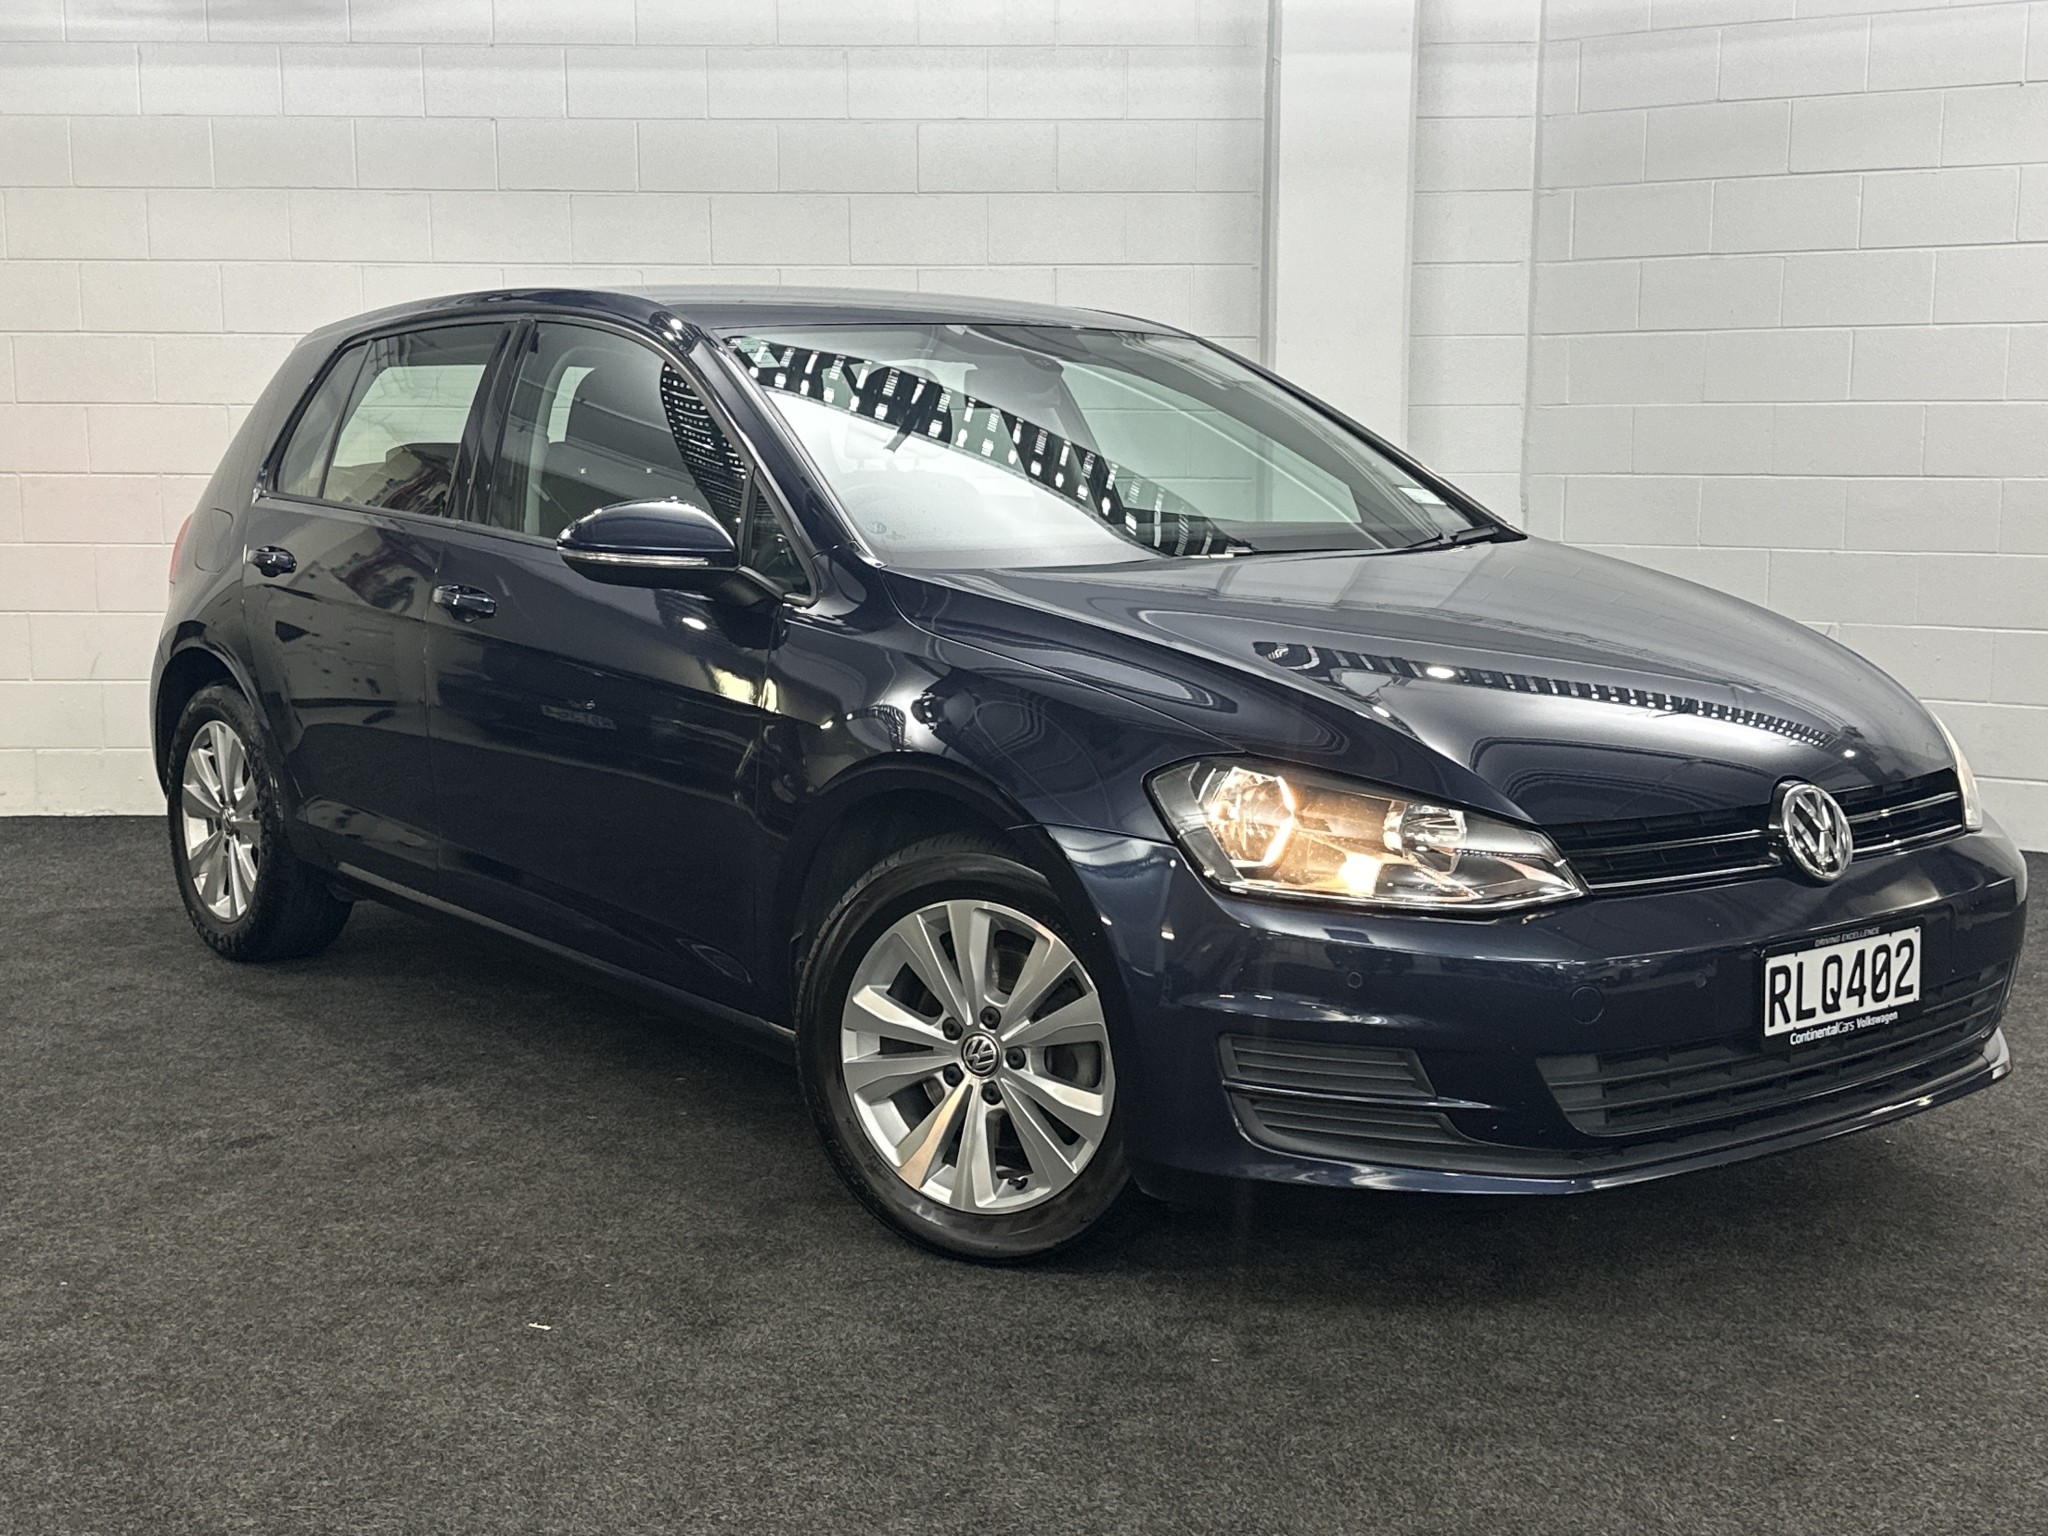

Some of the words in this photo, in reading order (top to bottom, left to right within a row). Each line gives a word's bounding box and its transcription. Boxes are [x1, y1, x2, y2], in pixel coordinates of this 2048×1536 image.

[1814, 934, 1841, 948] DRIVING
[1768, 938, 1915, 1028] RLQ402
[1856, 1011, 1898, 1029] Volkswagen
